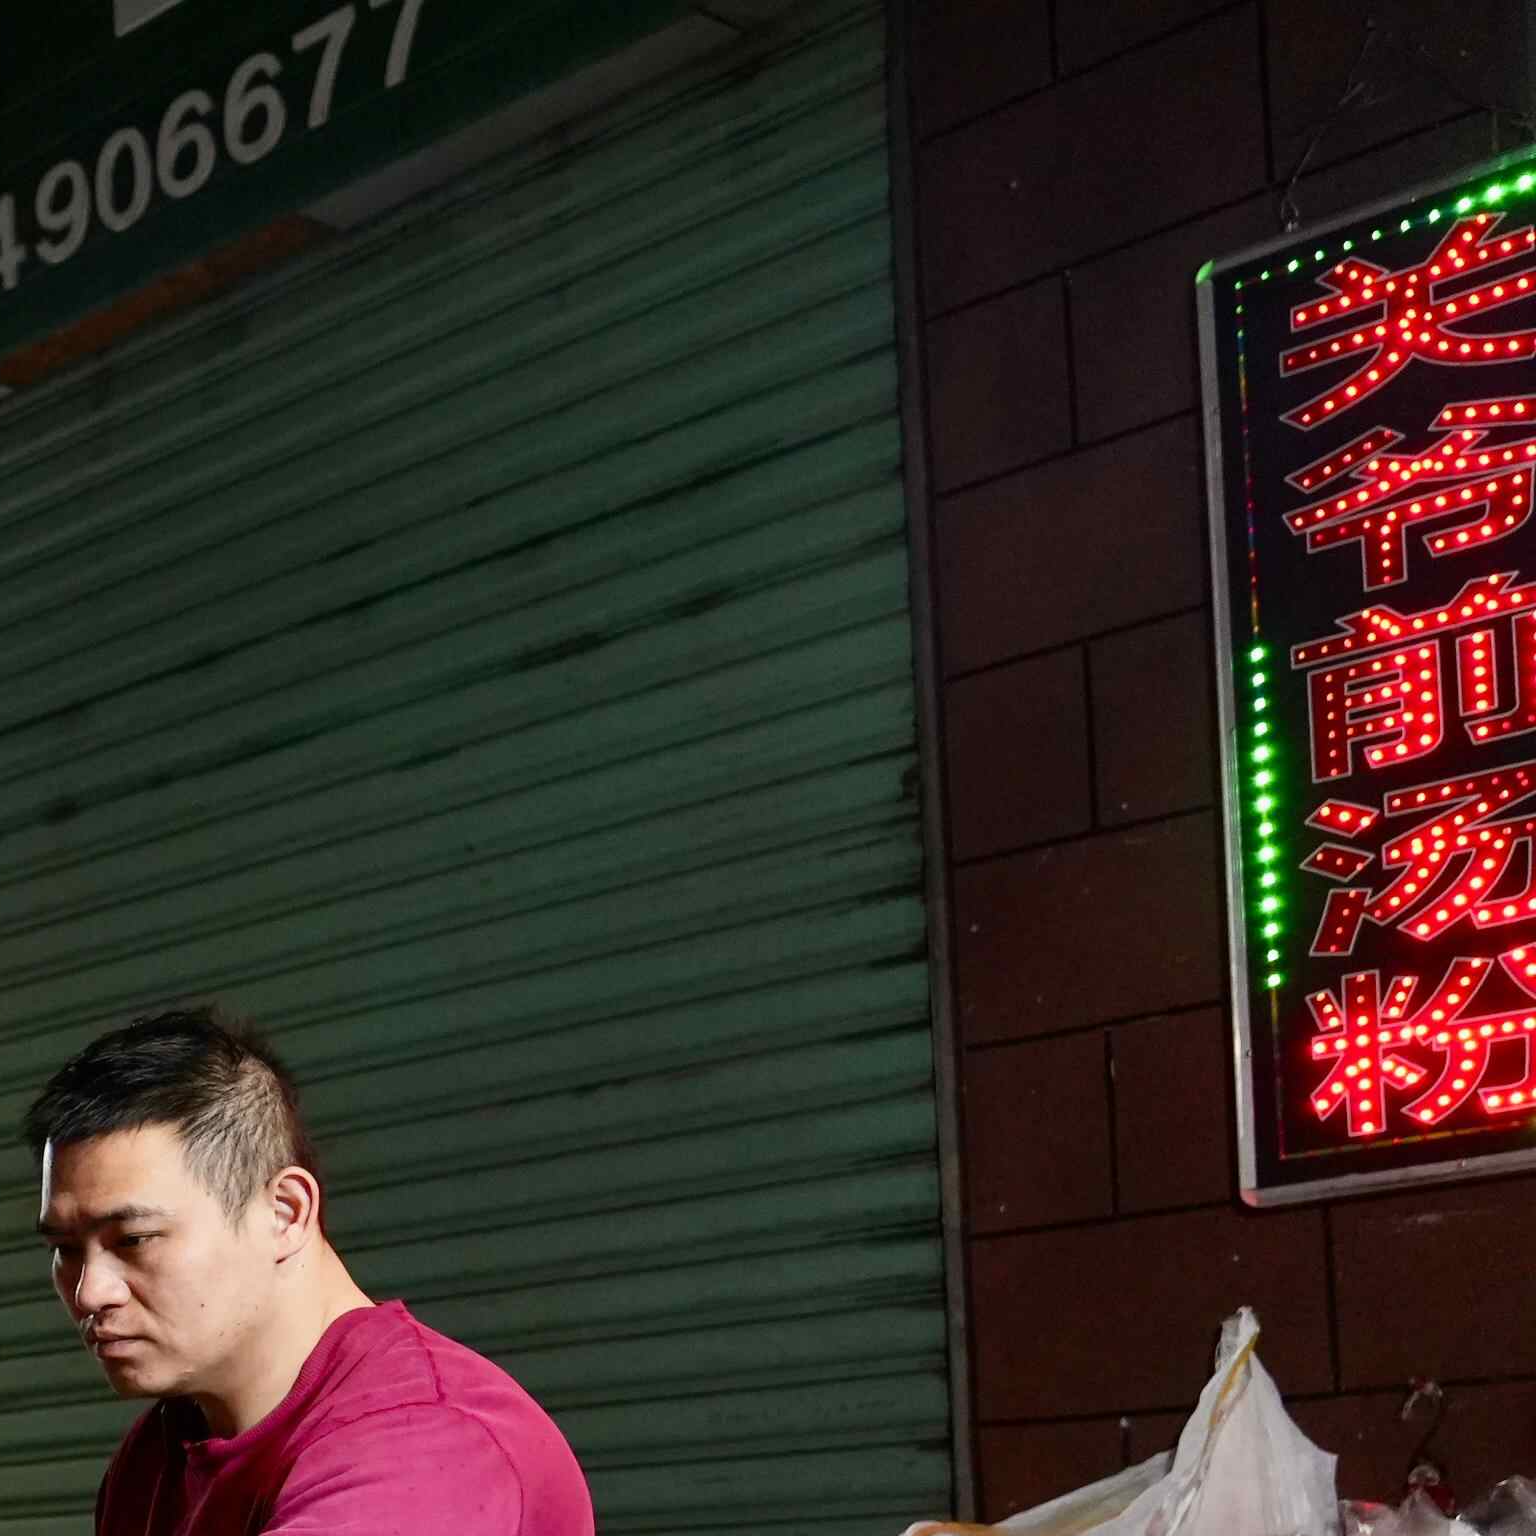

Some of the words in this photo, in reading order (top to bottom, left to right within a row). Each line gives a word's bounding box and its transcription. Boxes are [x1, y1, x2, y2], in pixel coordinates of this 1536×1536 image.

[1280, 212, 1536, 1137] 关爷前汤粉
